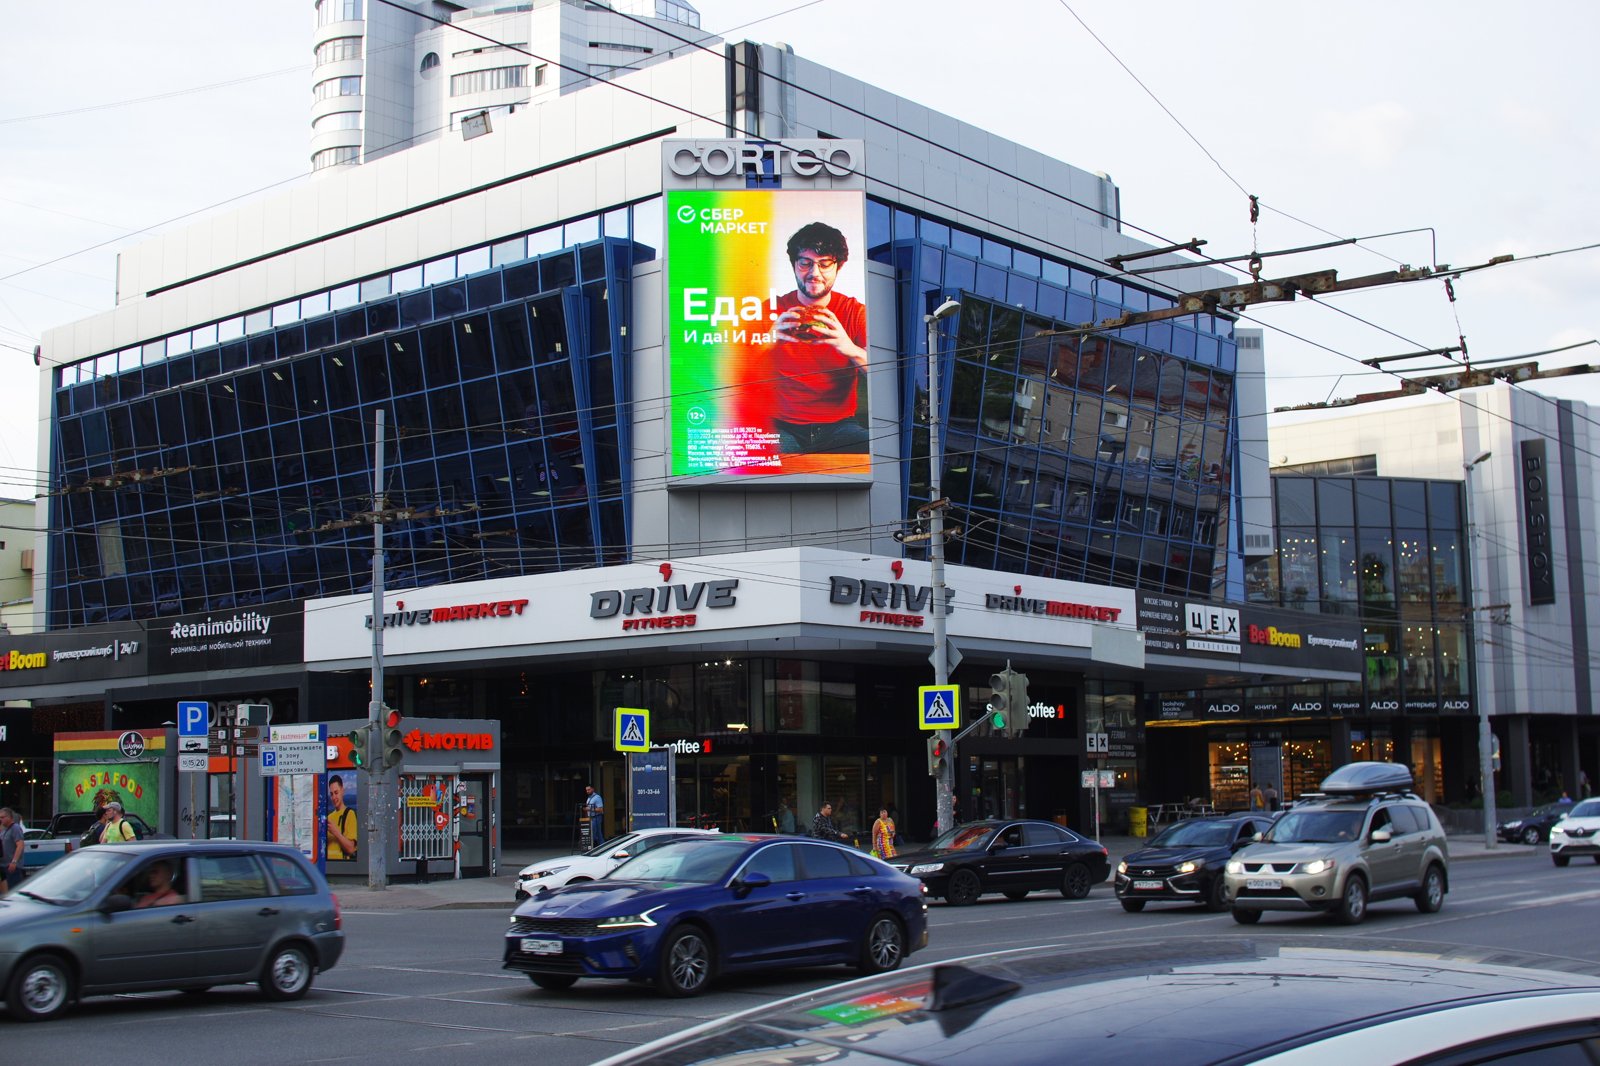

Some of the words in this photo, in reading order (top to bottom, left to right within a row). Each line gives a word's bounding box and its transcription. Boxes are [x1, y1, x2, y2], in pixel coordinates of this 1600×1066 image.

[700, 208, 744, 220] СБЕР
[700, 222, 768, 234] МАРКЕТ
[684, 288, 778, 326] Еда!
[684, 330, 697, 343] И
[702, 330, 729, 345] да!
[732, 330, 746, 343] И
[751, 330, 777, 345] да!
[690, 412, 704, 420] 12+
[590, 578, 739, 618] DRIVE
[171, 611, 270, 639] Reanimobility
[622, 614, 697, 630] FITNESS
[860, 610, 924, 627] FITNESS
[1192, 612, 1237, 632] ЦЕХ
[1248, 624, 1301, 648] BetBoom
[120, 641, 139, 655] 24/7
[209, 640, 244, 650] мобильной
[245, 638, 271, 647] техники
[1292, 703, 1322, 711] ALDO
[1370, 701, 1398, 710] ALDO
[1443, 701, 1470, 709] ALDO
[423, 733, 494, 750] МОТИВ
[196, 759, 205, 767] 20
[75, 771, 110, 798] RASTA
[113, 772, 143, 799] FOOD
